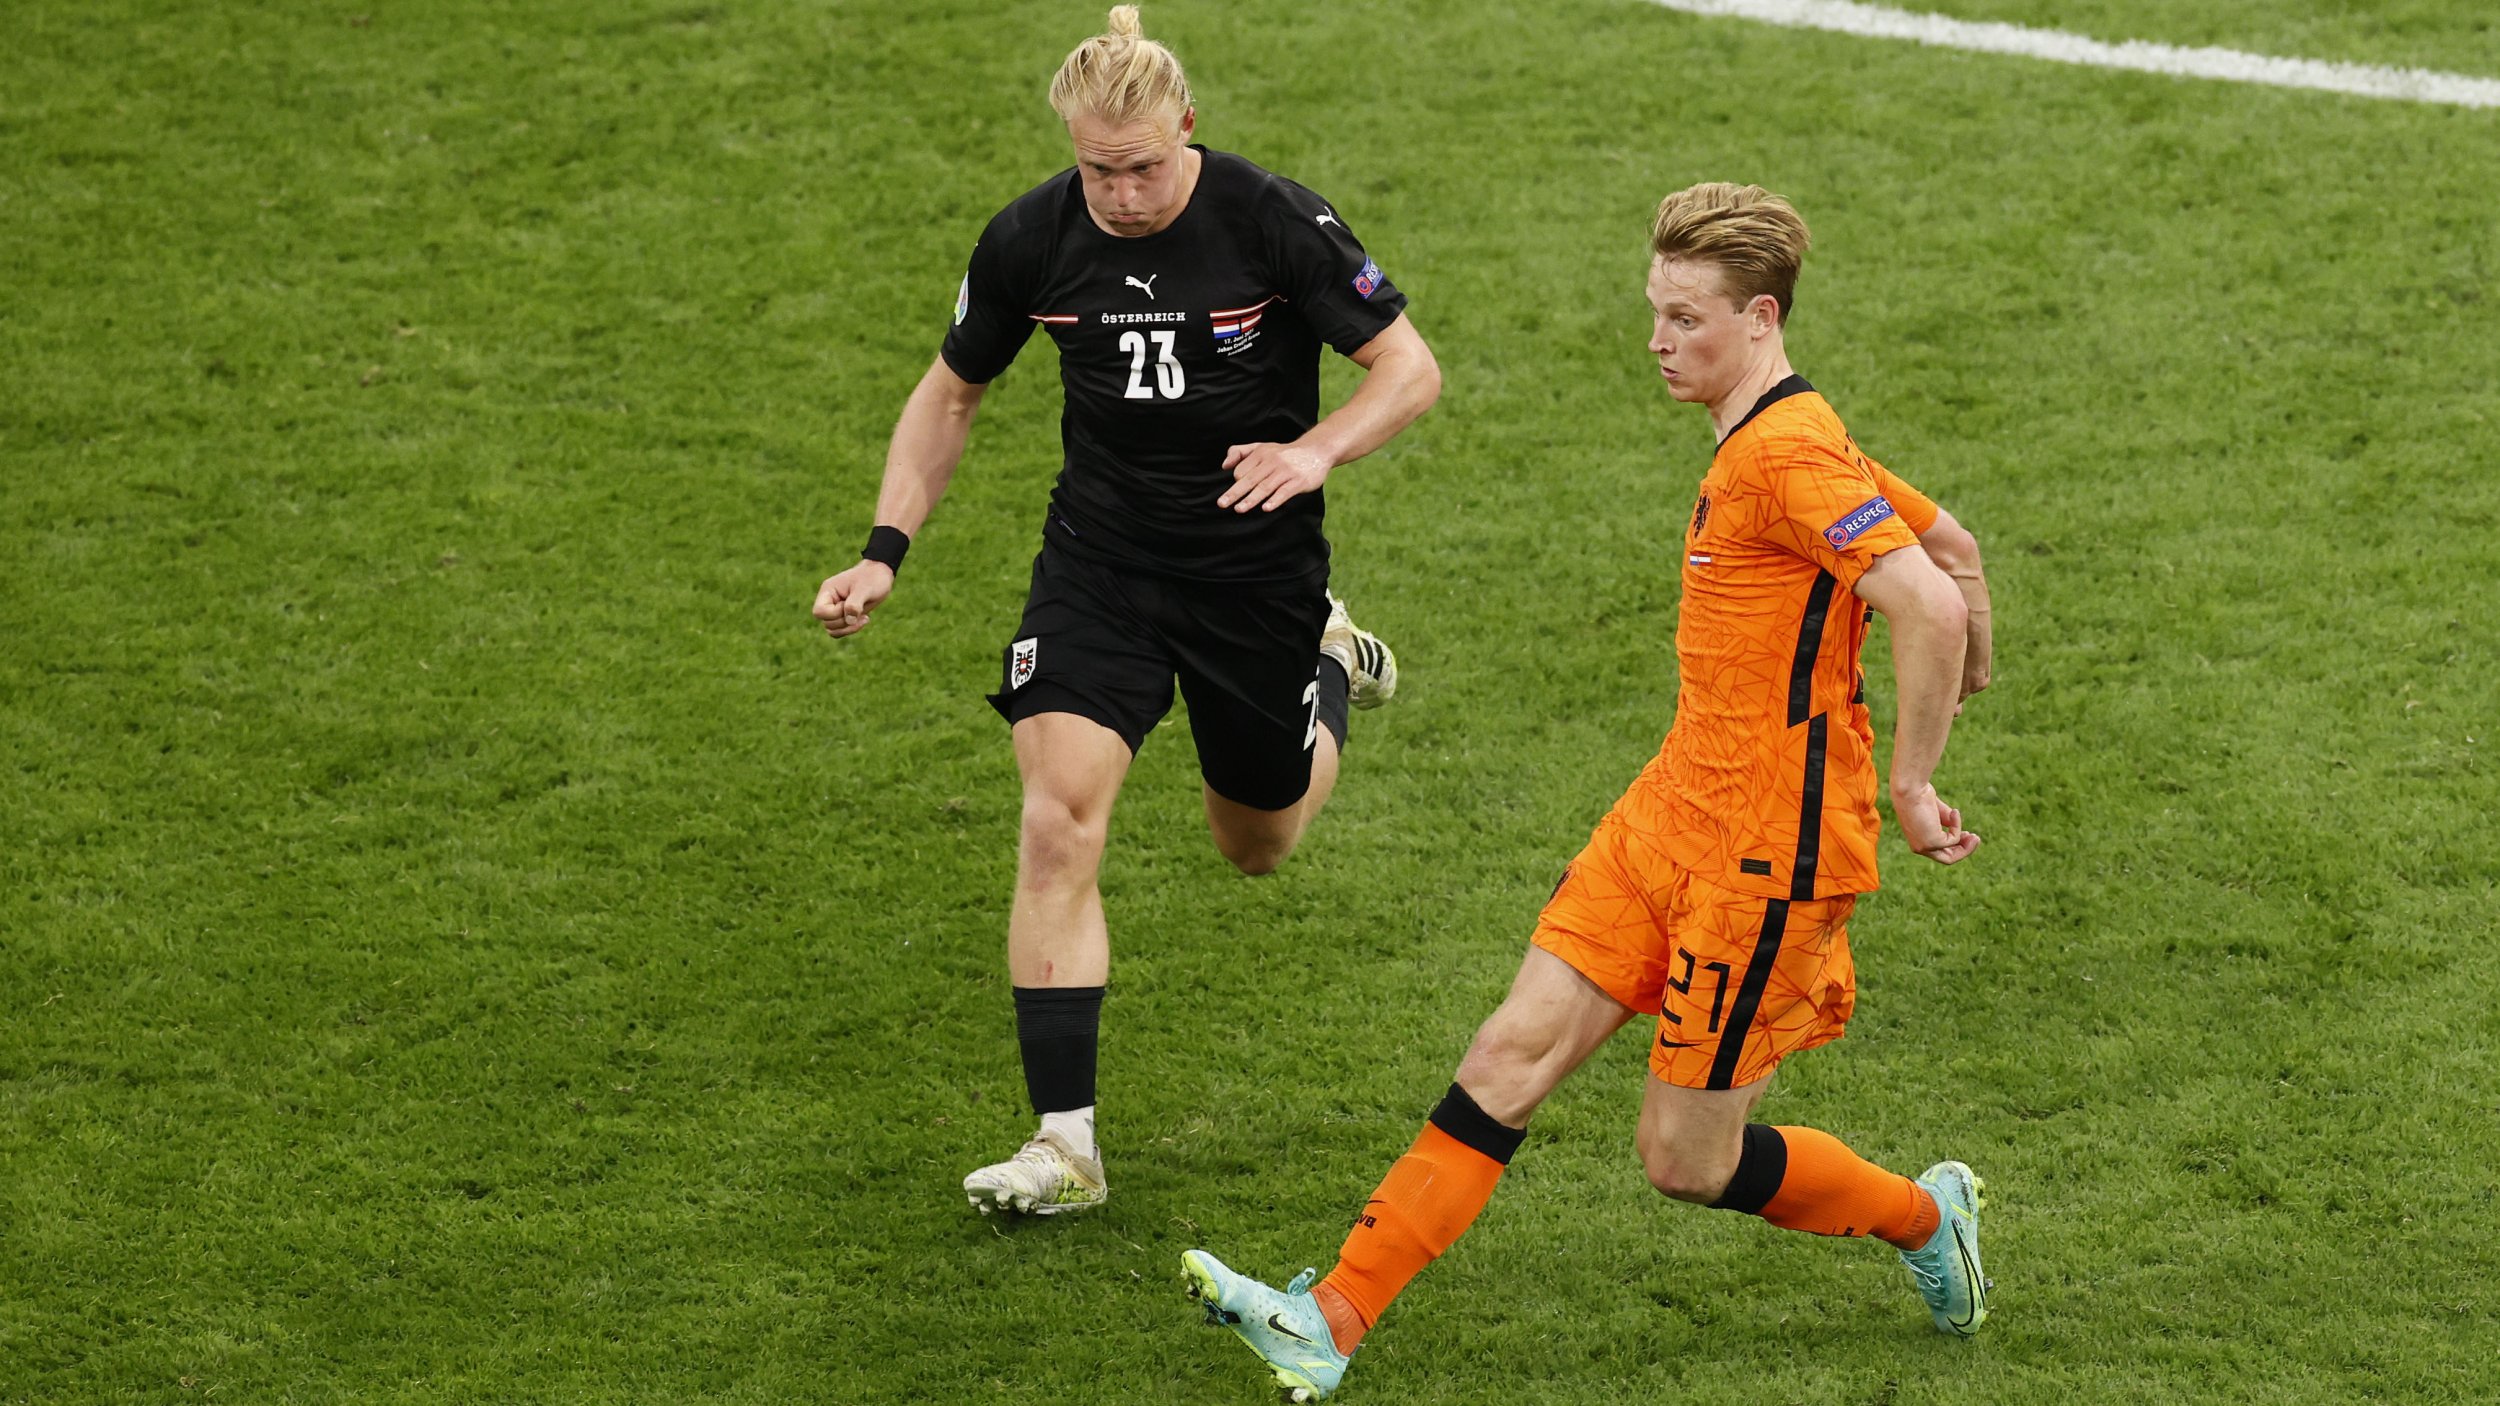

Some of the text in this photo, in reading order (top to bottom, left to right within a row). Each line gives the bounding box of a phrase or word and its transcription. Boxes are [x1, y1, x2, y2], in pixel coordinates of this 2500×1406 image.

[1101, 312, 1186, 324] ÖSTERREICH
[1118, 330, 1186, 400] 23
[1844, 500, 1890, 534] RESPECT
[1661, 946, 1731, 1033] 21
